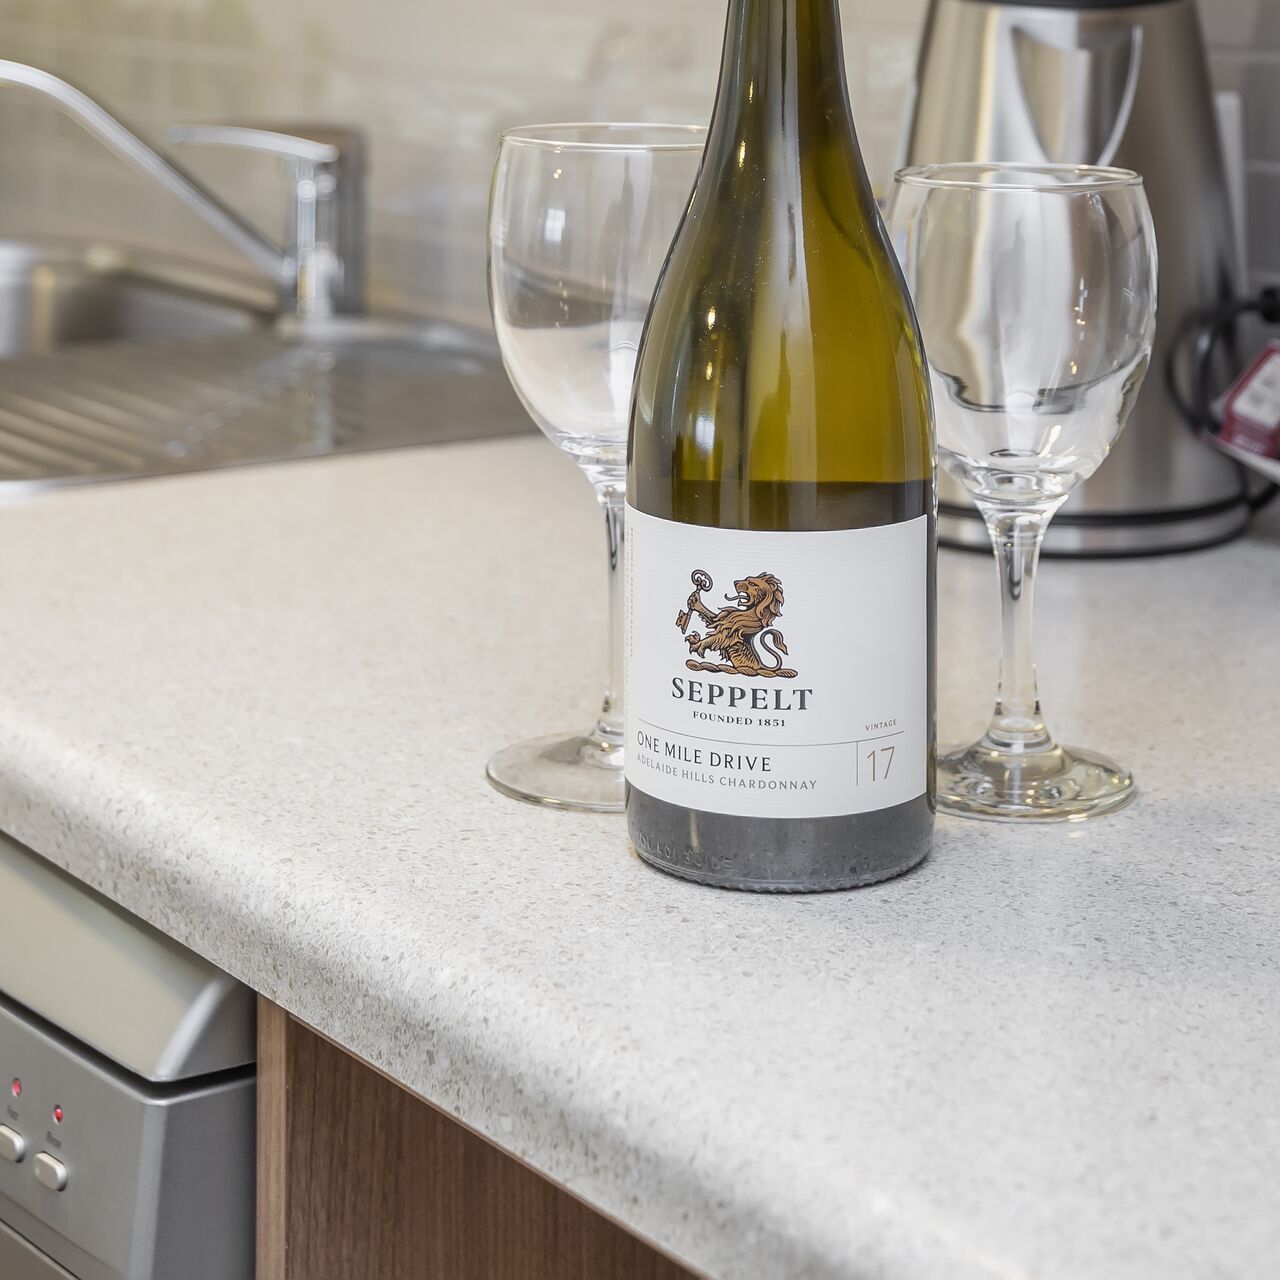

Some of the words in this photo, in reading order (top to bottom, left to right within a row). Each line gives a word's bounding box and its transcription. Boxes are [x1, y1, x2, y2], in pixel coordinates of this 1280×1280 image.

[672, 677, 813, 711] SEPPELT
[693, 711, 753, 727] FOUNDED
[758, 719, 786, 727] 1851
[865, 719, 897, 731] VINTAGE
[637, 730, 660, 753] ONE
[664, 742, 702, 765] MILE
[710, 752, 771, 772] DRIVE
[867, 746, 895, 782] 17
[637, 753, 678, 777] ADELAIDE
[682, 770, 715, 785] HILLS
[720, 776, 817, 790] CHARDONNAY
